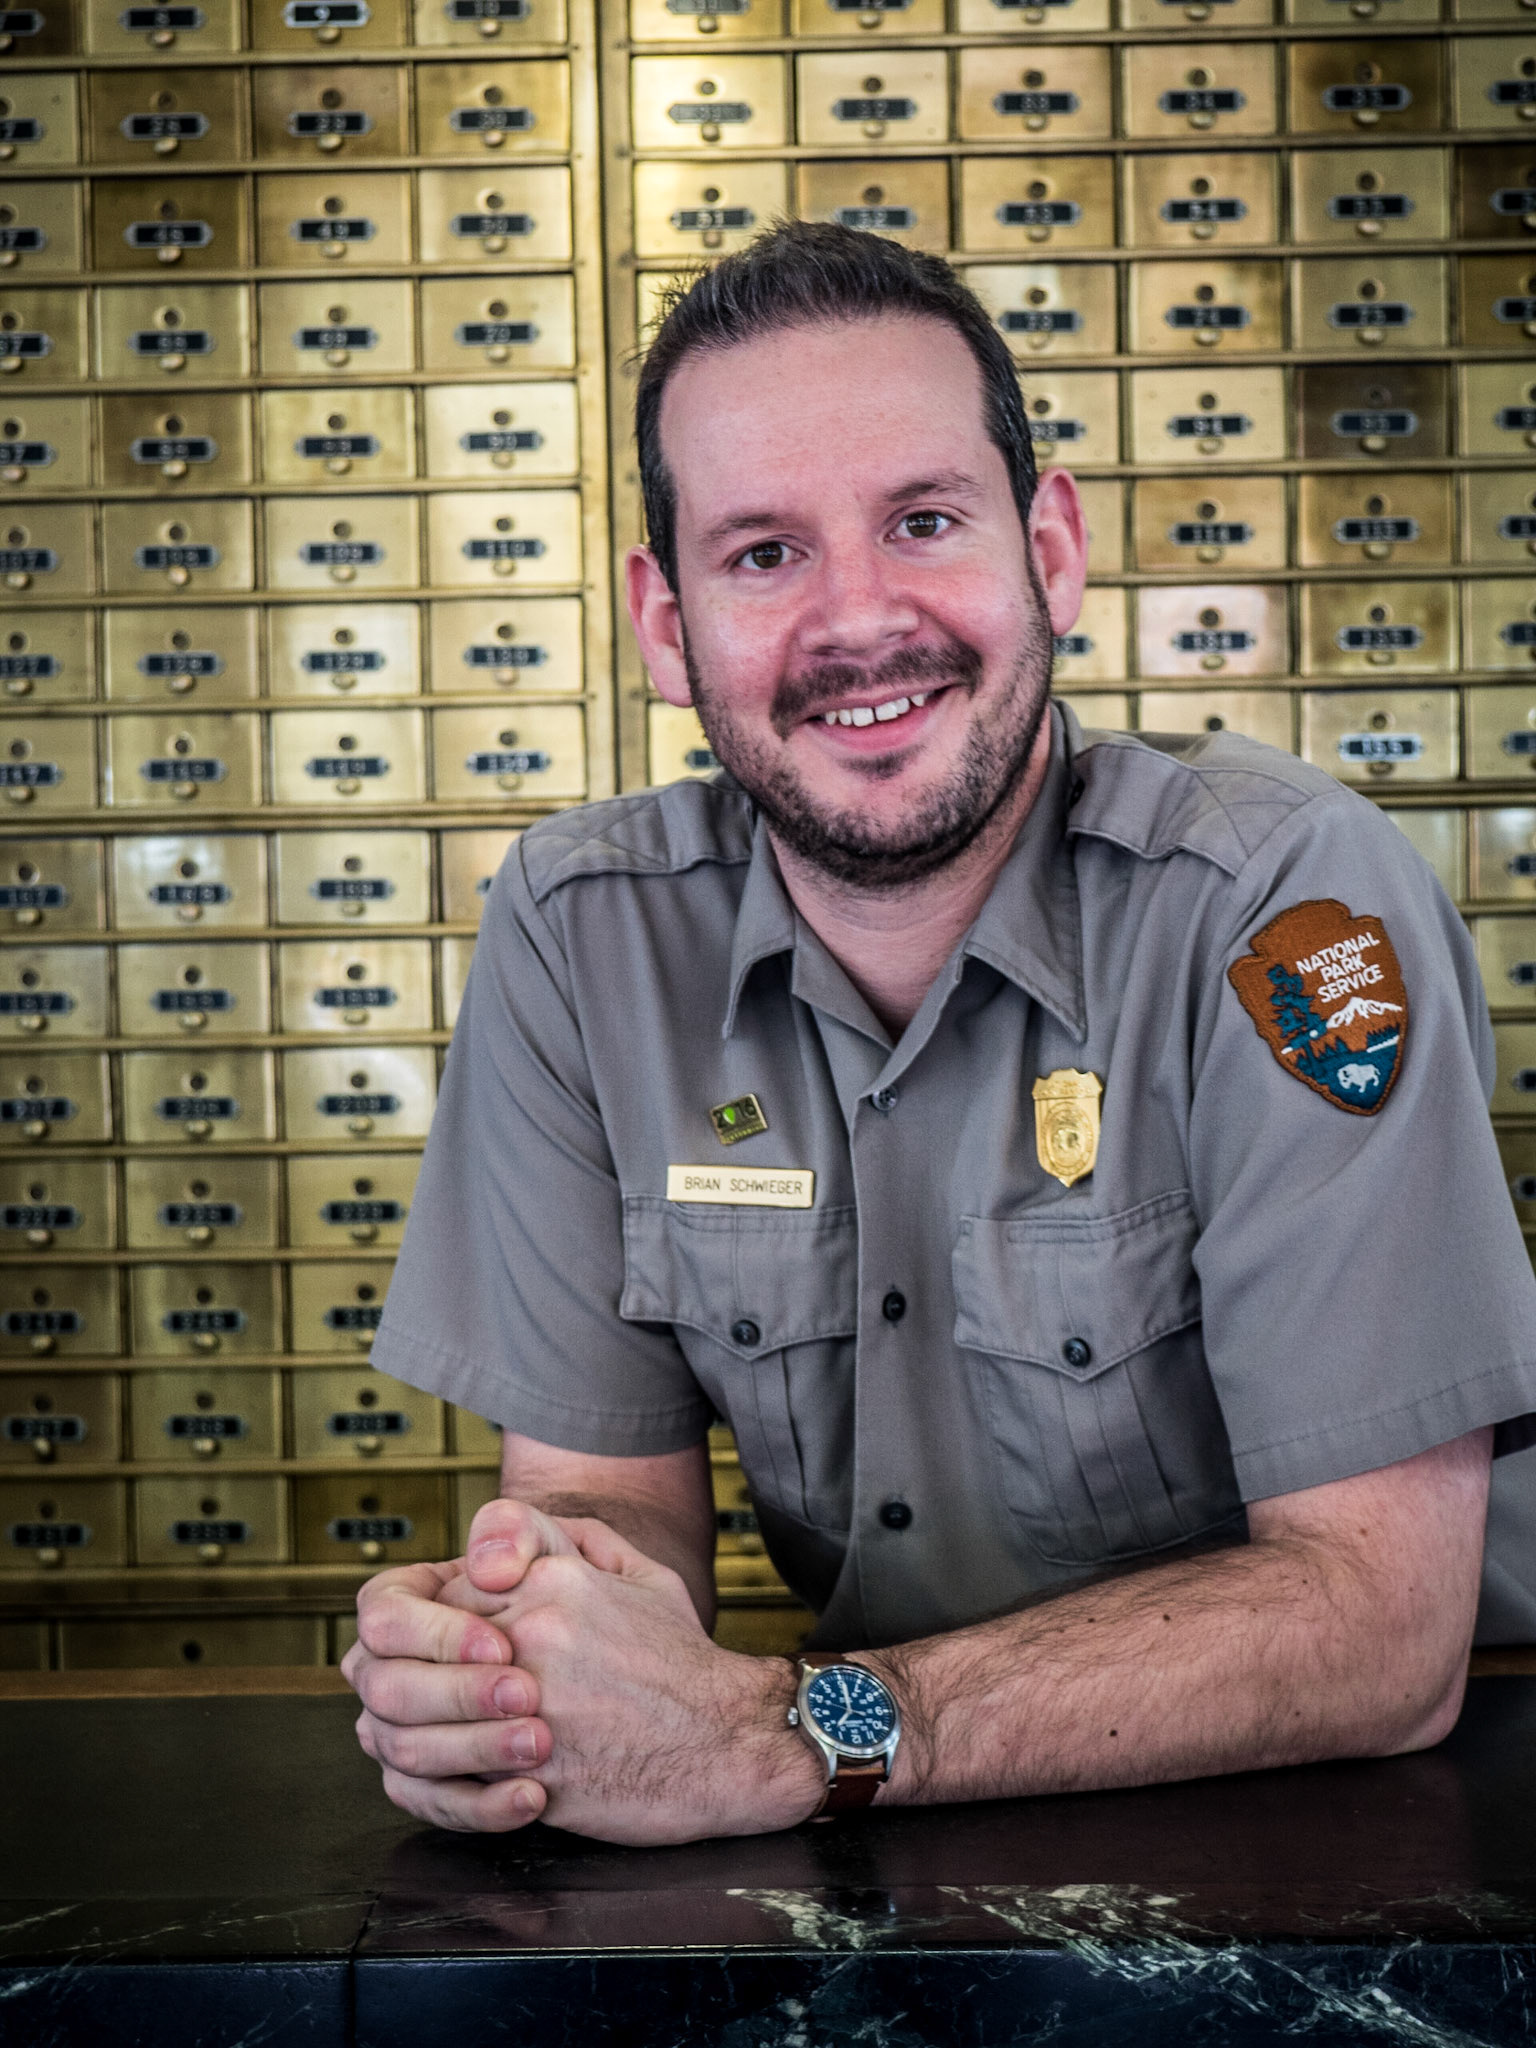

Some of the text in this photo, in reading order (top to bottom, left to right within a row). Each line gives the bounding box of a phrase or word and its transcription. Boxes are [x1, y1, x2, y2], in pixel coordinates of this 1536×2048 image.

[1296, 932, 1380, 975] NATIONAL
[1320, 953, 1367, 983] PARK
[1317, 964, 1385, 1003] SERVICE
[684, 1176, 803, 1195] BRIAN SCHWIEGER
